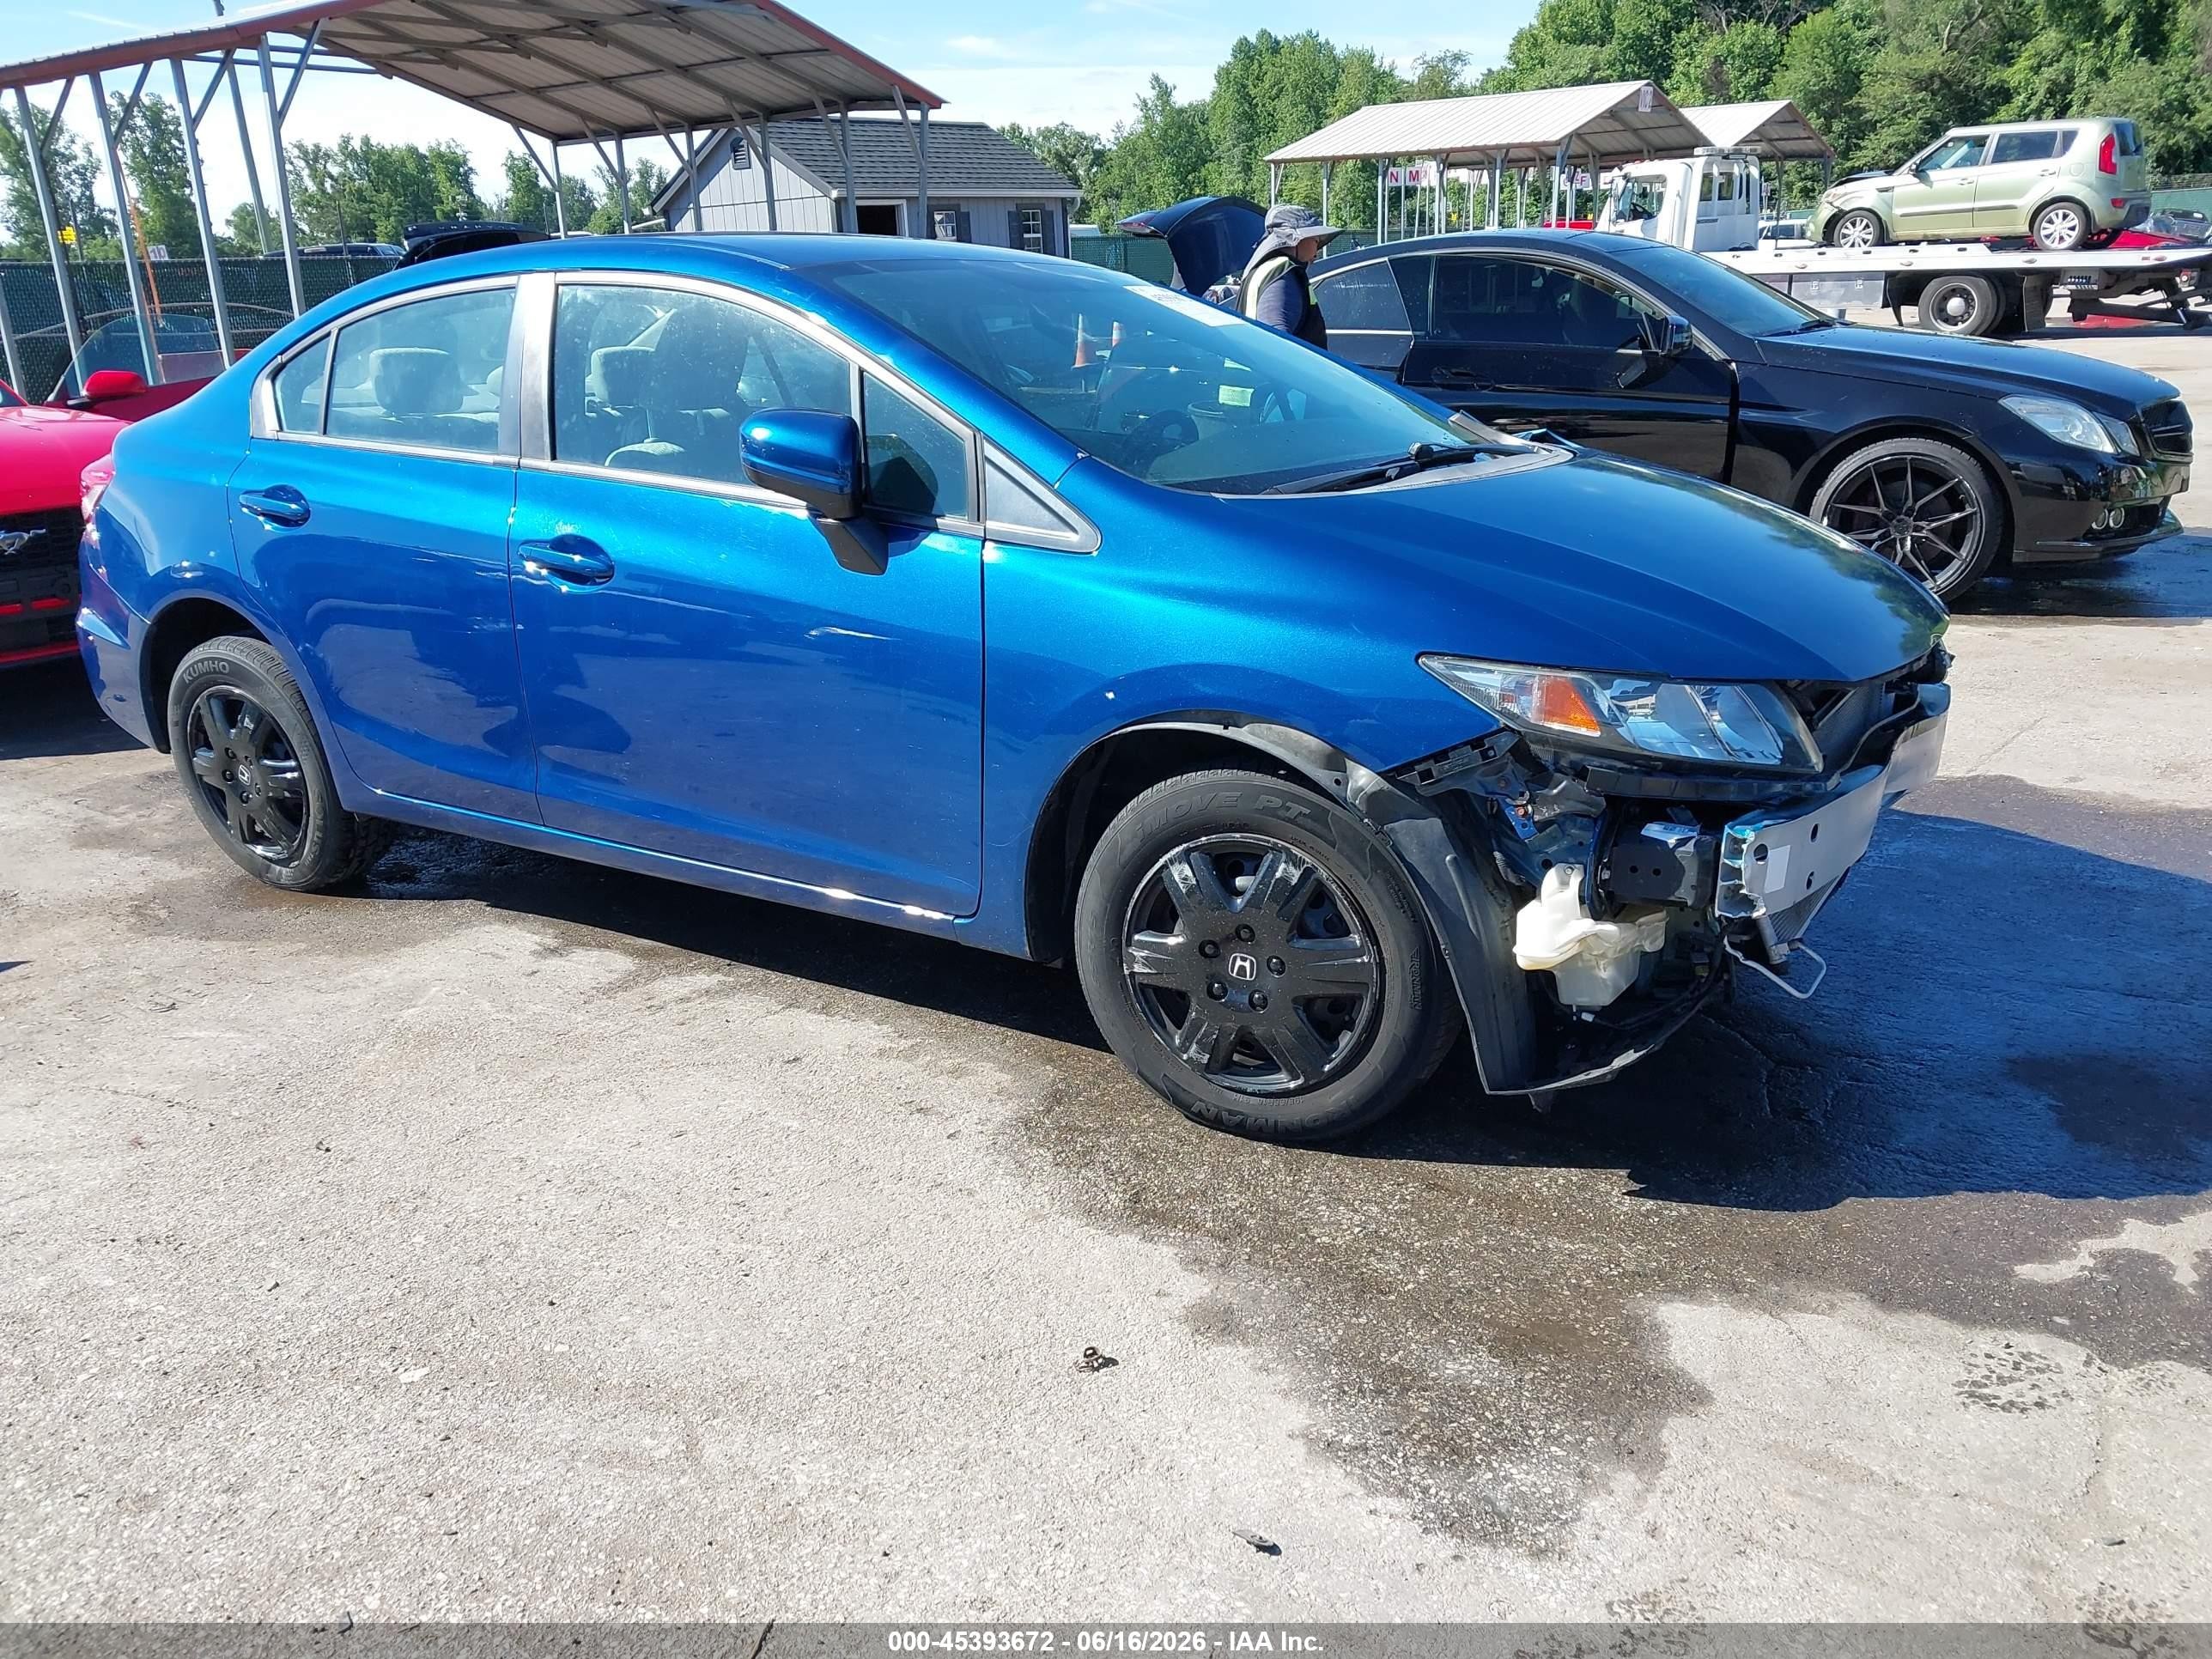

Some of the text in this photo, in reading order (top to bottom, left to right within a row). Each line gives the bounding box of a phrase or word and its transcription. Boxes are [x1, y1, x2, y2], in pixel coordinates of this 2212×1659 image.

[1389, 171, 1399, 183] N
[1408, 170, 1419, 183] M
[1580, 175, 1587, 185] F
[183, 660, 229, 684] KUMHO
[1254, 794, 1311, 820] PT
[1408, 956, 1423, 1011] IRONMAN
[1190, 1099, 1357, 1136] ONMAN
